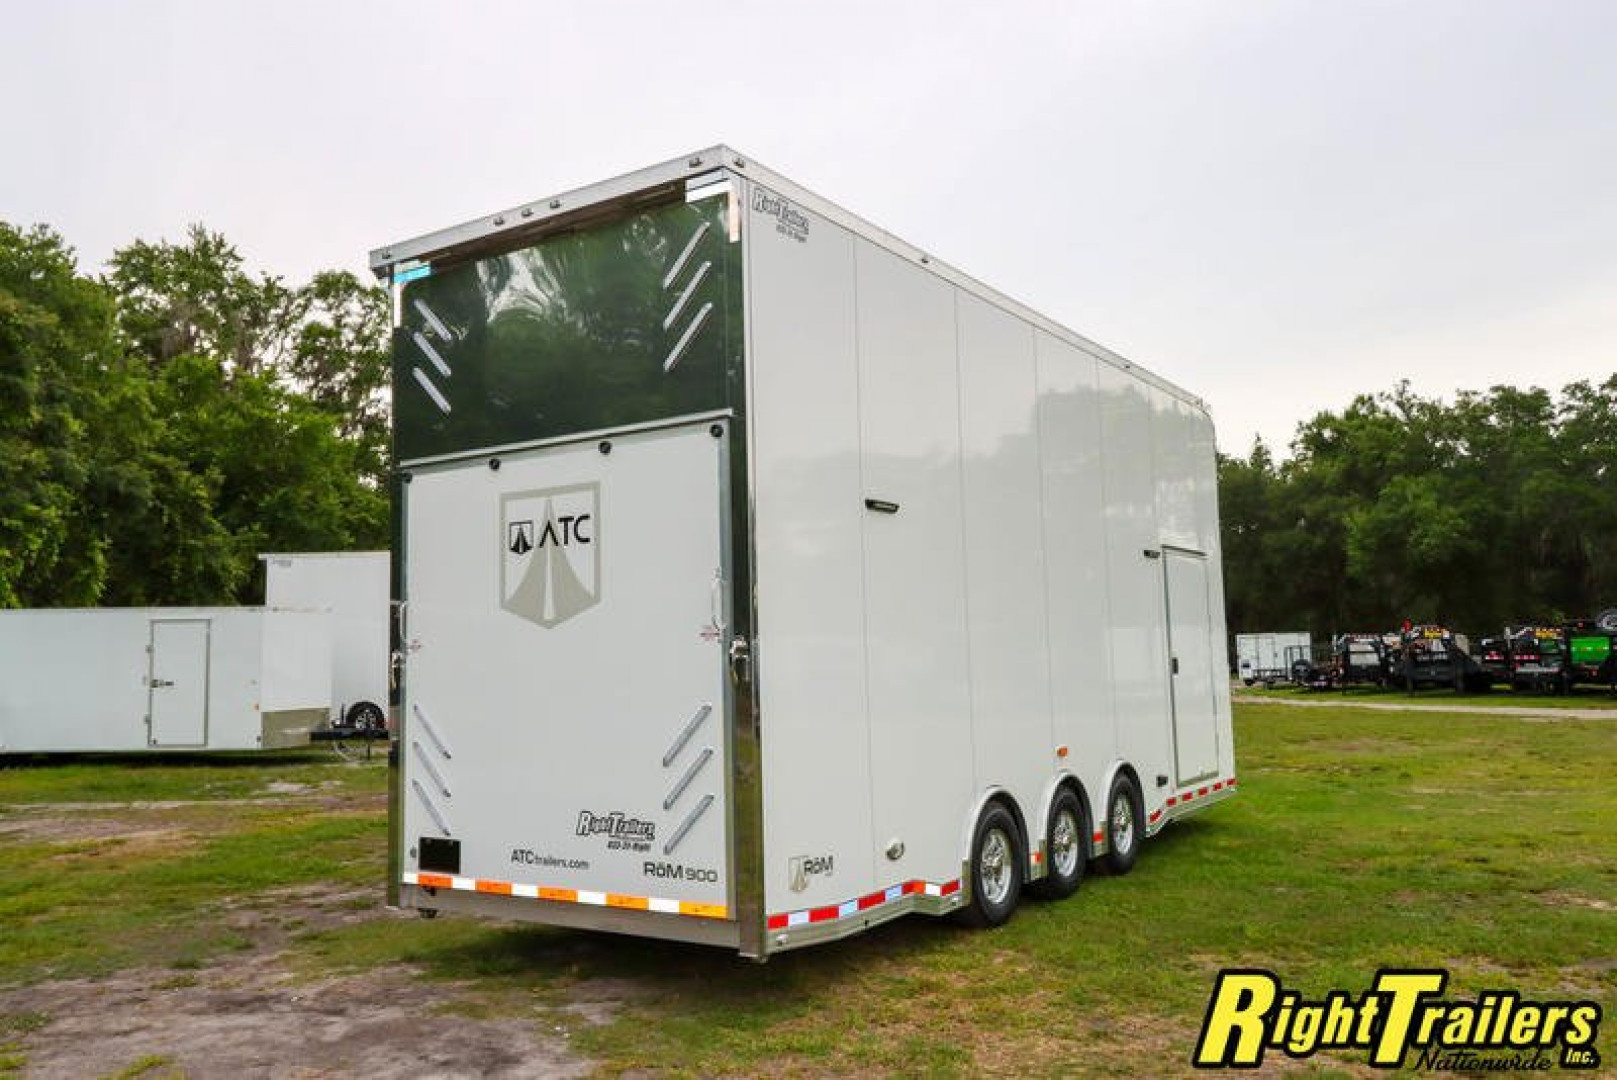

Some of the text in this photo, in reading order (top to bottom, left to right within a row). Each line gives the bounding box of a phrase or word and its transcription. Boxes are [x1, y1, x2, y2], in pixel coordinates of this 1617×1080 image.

[539, 513, 591, 548] ATC
[511, 850, 589, 869] ATCtrailers.com
[685, 868, 718, 882] 900
